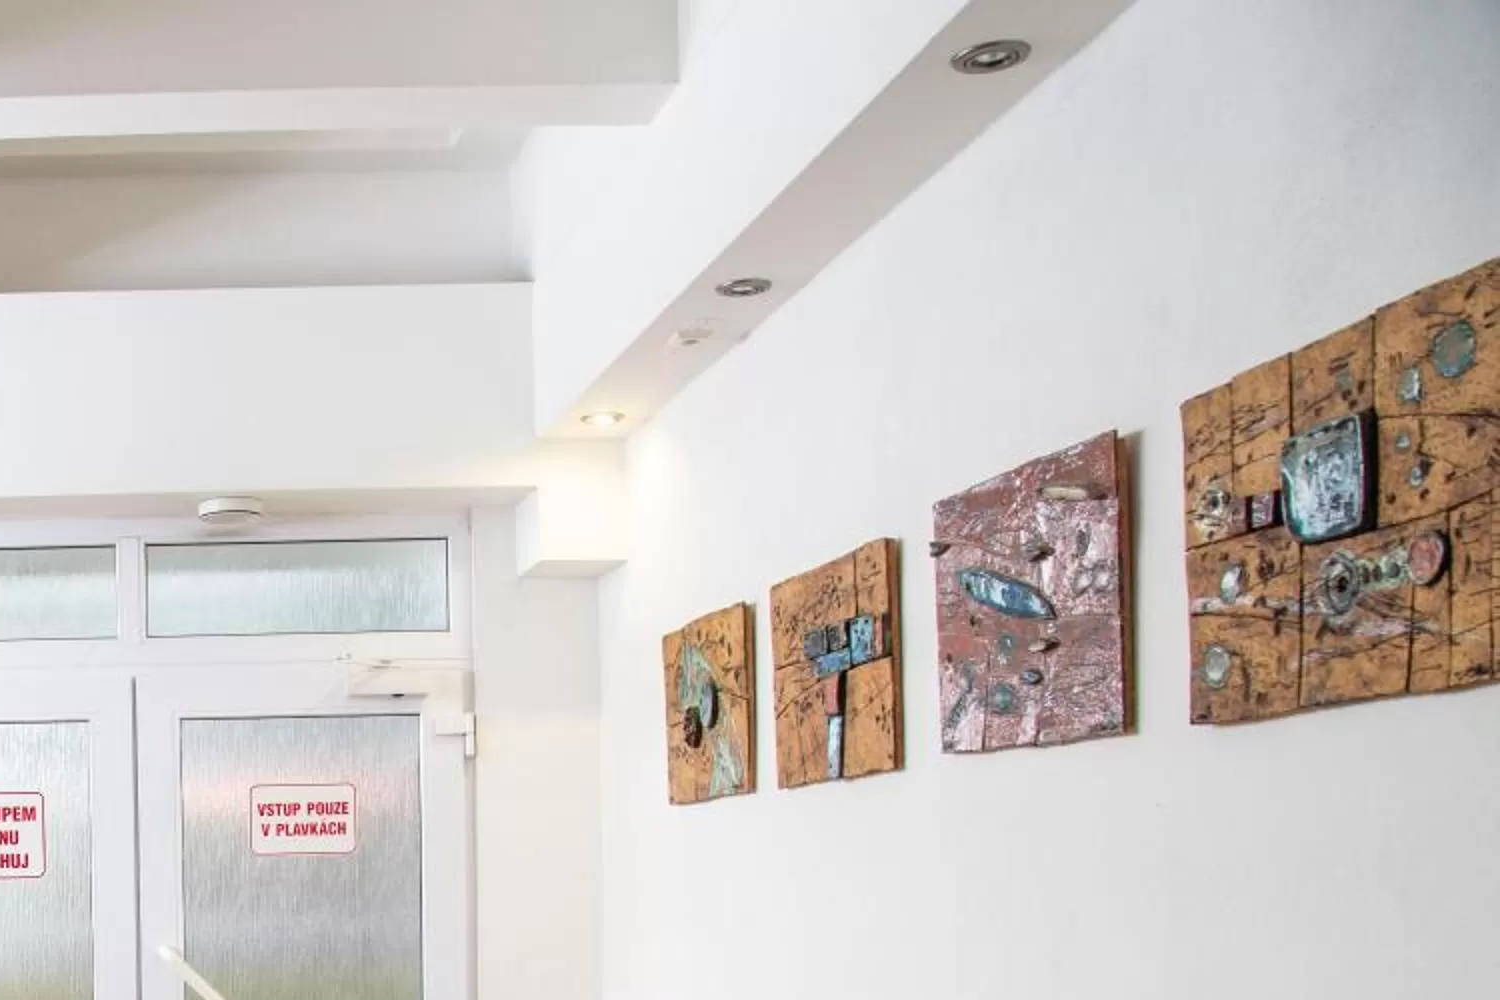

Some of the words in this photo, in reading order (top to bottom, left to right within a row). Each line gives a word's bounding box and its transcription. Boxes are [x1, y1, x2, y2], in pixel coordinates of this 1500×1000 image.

[257, 803, 301, 817] VSTUP
[307, 801, 349, 816] POUZE
[261, 823, 270, 837] V
[275, 818, 347, 837] PLAVKÁCH
